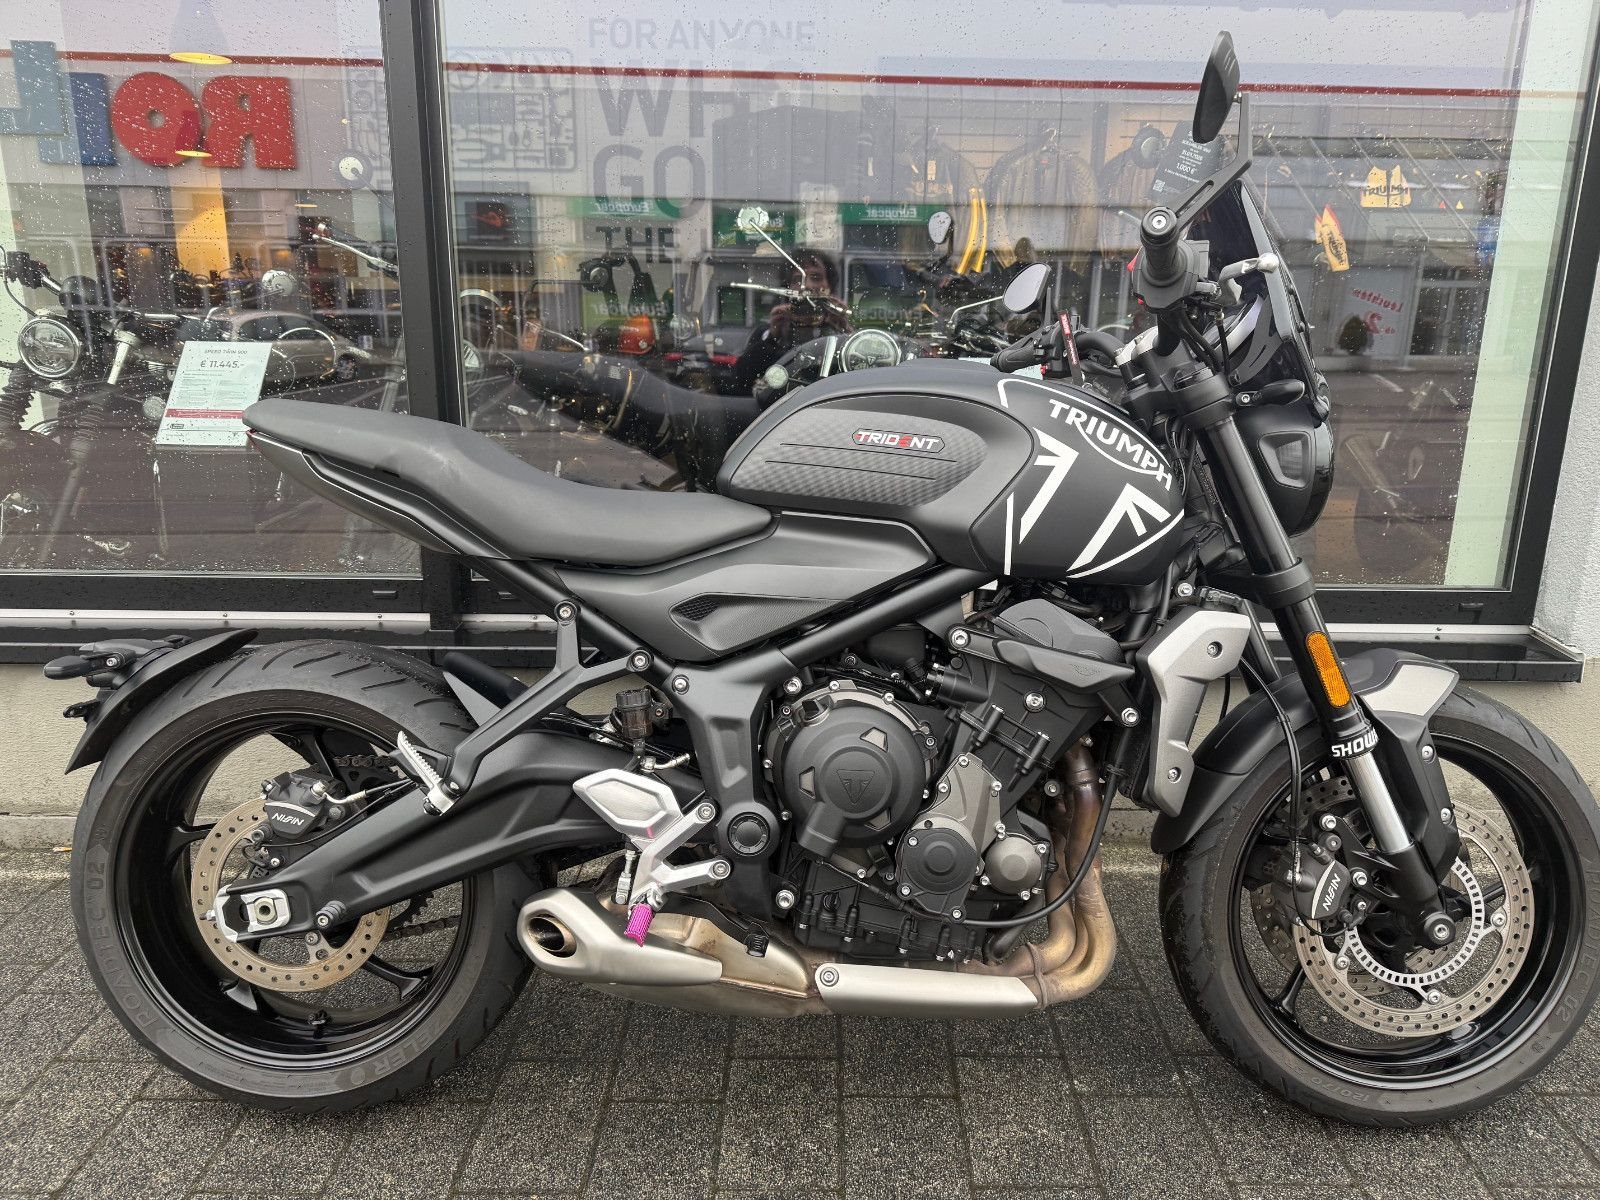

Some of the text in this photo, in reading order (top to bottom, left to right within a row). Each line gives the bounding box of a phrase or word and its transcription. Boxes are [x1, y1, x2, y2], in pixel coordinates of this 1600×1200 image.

[589, 18, 815, 50] FOR ANYONE
[590, 59, 800, 137] WH
[596, 227, 681, 263] THE
[856, 431, 940, 450] TRIDENT
[1049, 399, 1173, 492] TRIUMPH
